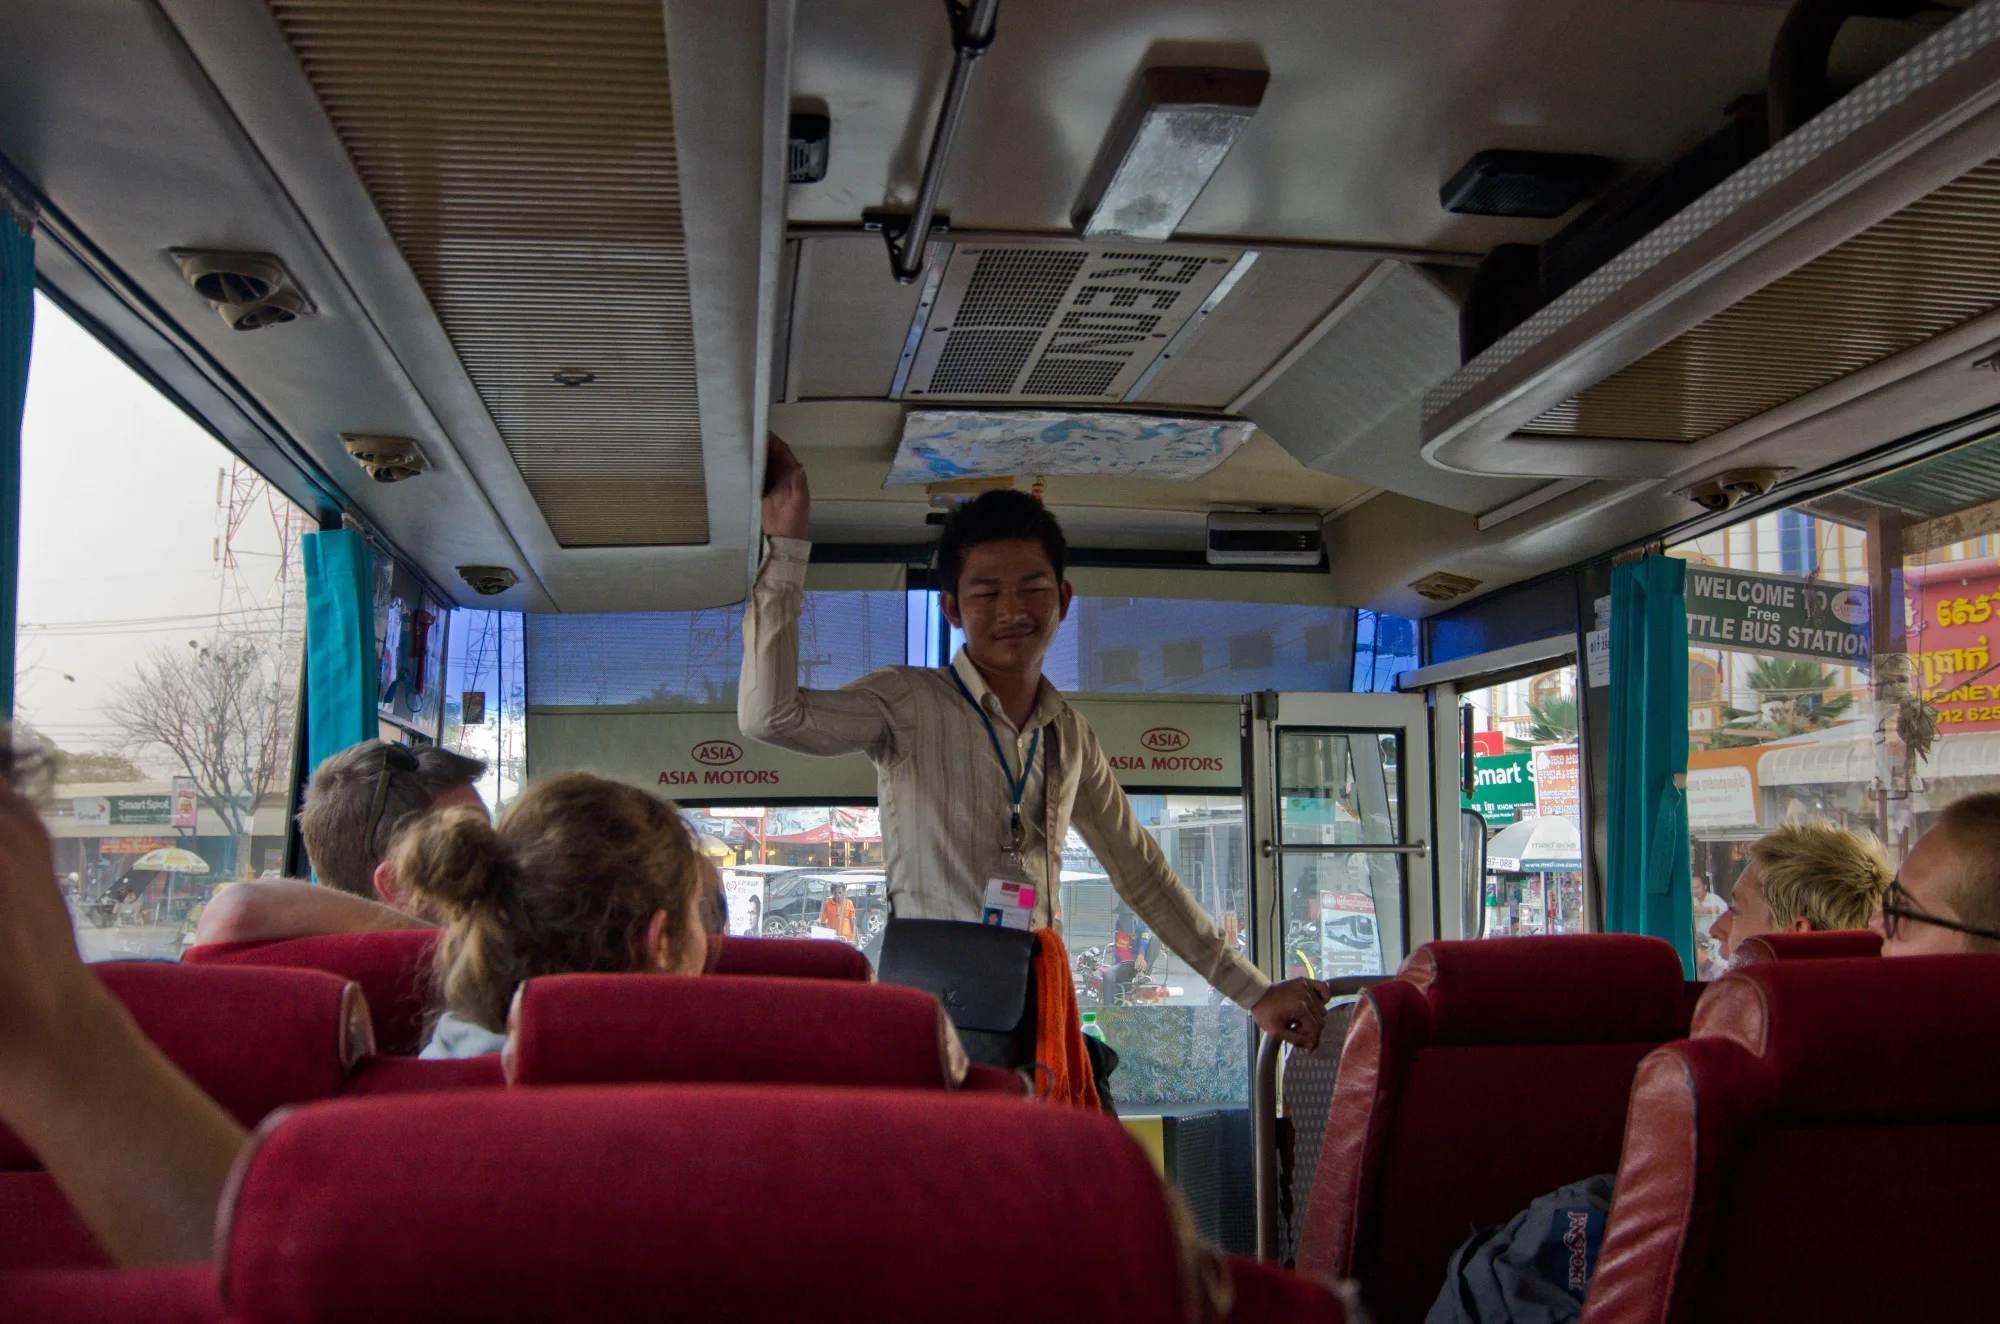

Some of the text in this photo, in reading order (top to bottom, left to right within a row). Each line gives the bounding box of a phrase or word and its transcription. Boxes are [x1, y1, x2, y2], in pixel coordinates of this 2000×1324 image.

[1694, 575, 1795, 608] WELCOME
[1747, 606, 1780, 622] Free
[1740, 620, 1781, 645] BUS
[1787, 626, 1870, 656] STATION
[1148, 733, 1182, 747] ASIA
[699, 746, 735, 760] ASIA
[1109, 756, 1223, 771] ASIA MOTORS
[657, 770, 780, 785] ASIA MOTORS
[117, 799, 170, 812] Smart Spot
[1531, 840, 1576, 849] metfone
